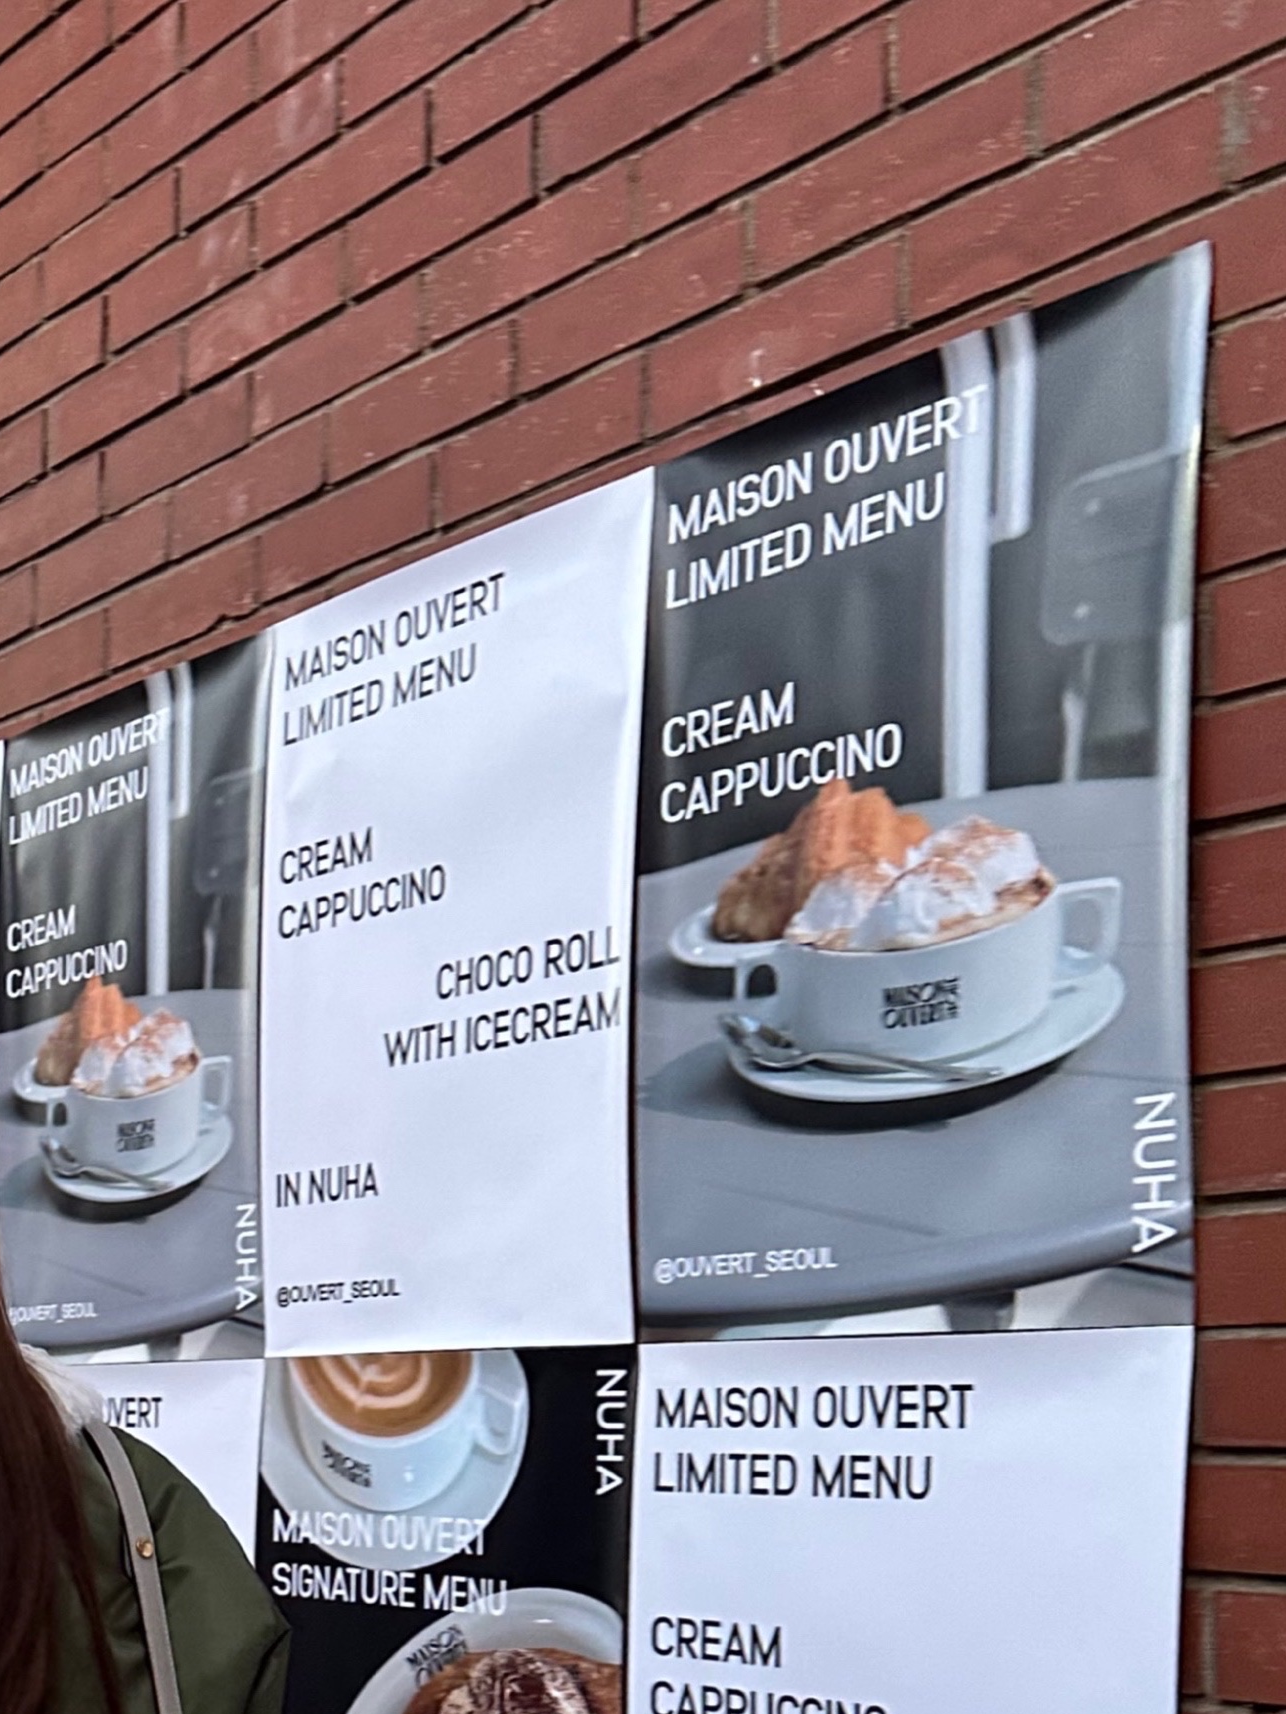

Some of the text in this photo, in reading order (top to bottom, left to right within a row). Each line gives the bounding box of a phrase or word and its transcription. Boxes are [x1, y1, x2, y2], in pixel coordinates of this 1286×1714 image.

[668, 384, 988, 545] MAISON OUVERT
[666, 471, 946, 610] LIMITED MENU
[285, 572, 506, 691] MAISON OUVERT
[283, 643, 477, 746] LIMITED MENU
[662, 681, 795, 758] CREAM
[10, 707, 170, 798] MAISON OUVERT
[660, 722, 903, 823] CAPPUCCINO
[9, 766, 148, 844] LIMITED MENU
[280, 827, 373, 885] CREAM
[6, 905, 76, 952] CREAM
[278, 865, 446, 940] CAPPUCCINO
[6, 940, 128, 1000] CAPPUCCINO
[436, 926, 621, 999] CHOCO ROLL
[383, 988, 622, 1067] WITH ICECREAM
[276, 1162, 379, 1208] IN NUHA
[1131, 1092, 1177, 1254] NUHA
[236, 1204, 258, 1311] NUHA
[277, 1278, 401, 1307] @OUVERT_SEOUL
[654, 1247, 838, 1284] @OUVERT_SEOUL
[595, 1368, 628, 1496] NUHA
[655, 1383, 974, 1430] MAISON OUVERT
[653, 1452, 933, 1500] LIMITED MENU
[273, 1509, 489, 1556] MAISON OUVERT
[272, 1562, 507, 1616] SIGNATURE MENU
[651, 1616, 782, 1669] CREAM
